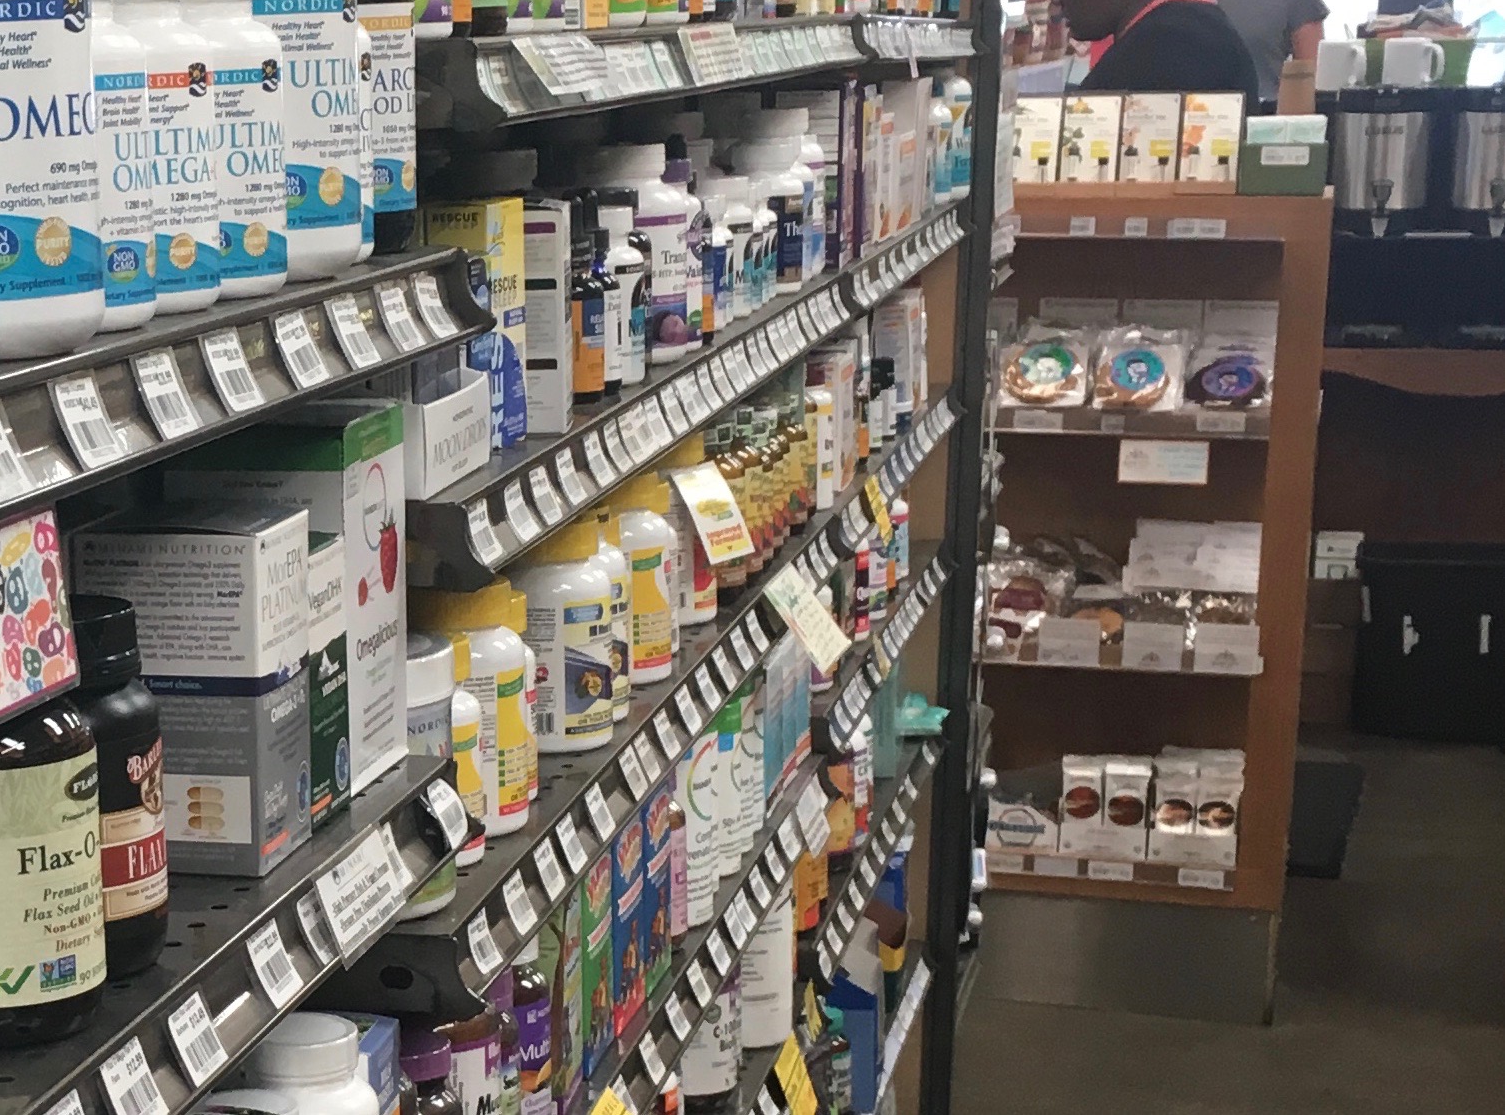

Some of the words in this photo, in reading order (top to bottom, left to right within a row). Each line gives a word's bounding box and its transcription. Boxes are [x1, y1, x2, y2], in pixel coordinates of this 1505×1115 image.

[5, 183, 42, 195] Perfect
[432, 212, 479, 224] RESCUE
[114, 251, 135, 262] NON
[113, 260, 136, 272] GMO
[158, 543, 245, 556] NUTRITION
[355, 617, 400, 662] Omegalicious
[43, 881, 89, 902] Premium
[23, 907, 53, 924] Flax
[56, 899, 81, 917] Seed
[44, 914, 92, 937] Non-GMO
[56, 934, 91, 954] Dietary
